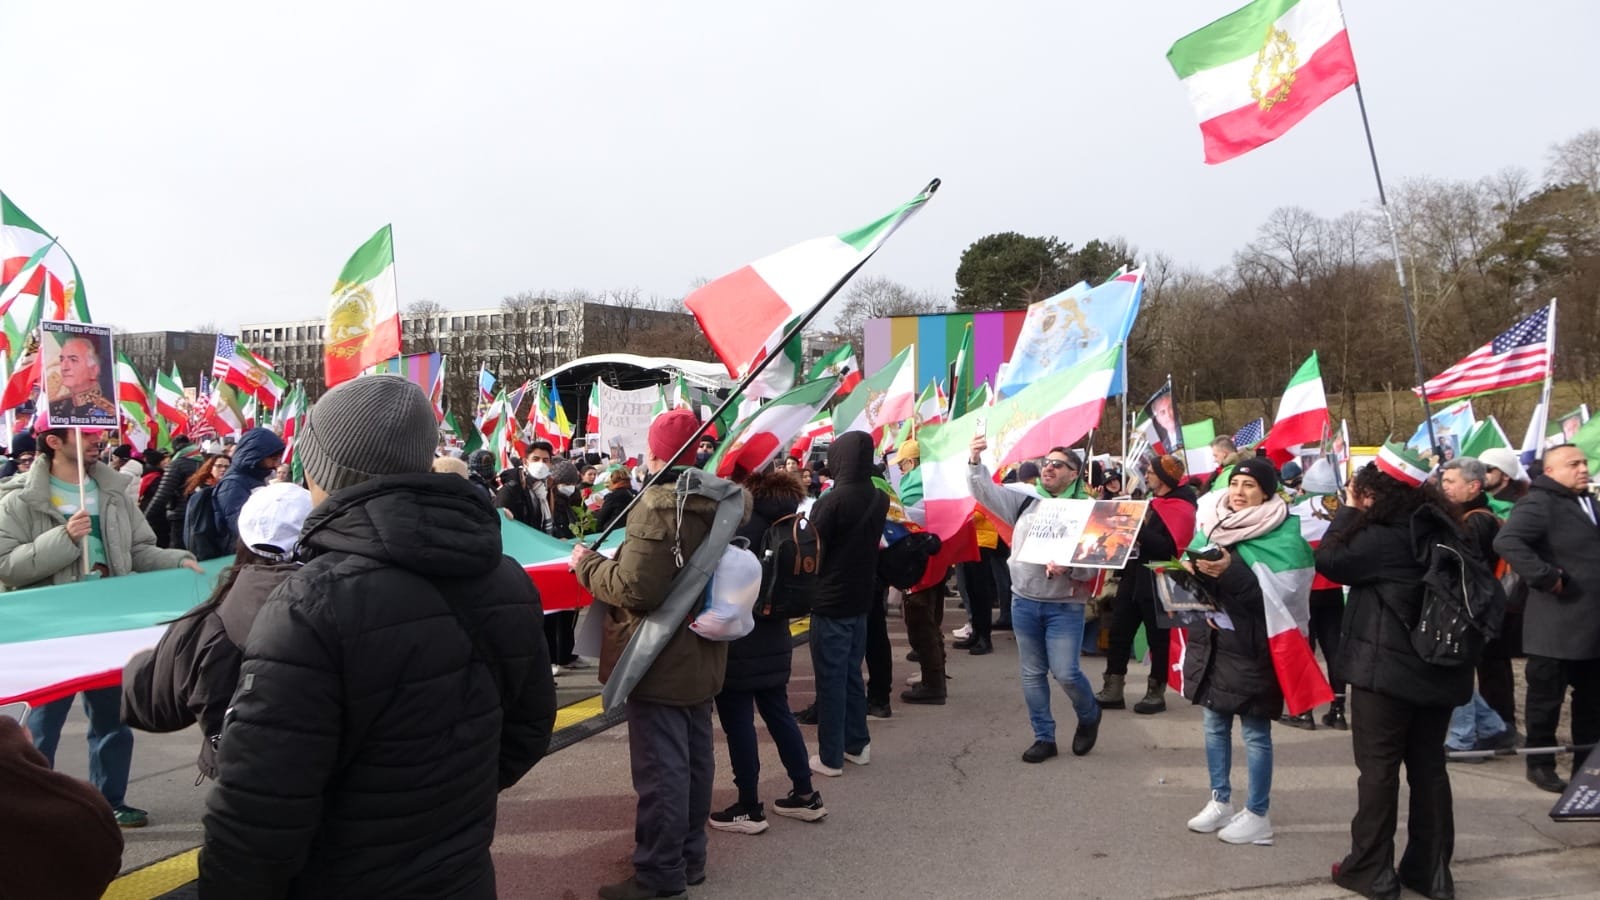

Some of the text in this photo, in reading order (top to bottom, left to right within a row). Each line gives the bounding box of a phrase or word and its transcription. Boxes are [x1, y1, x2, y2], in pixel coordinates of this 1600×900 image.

[44, 322, 110, 336] King Reza Pahlavi
[51, 415, 116, 425] King Reza Pahlavi
[1028, 531, 1064, 540] PAHLAVI
